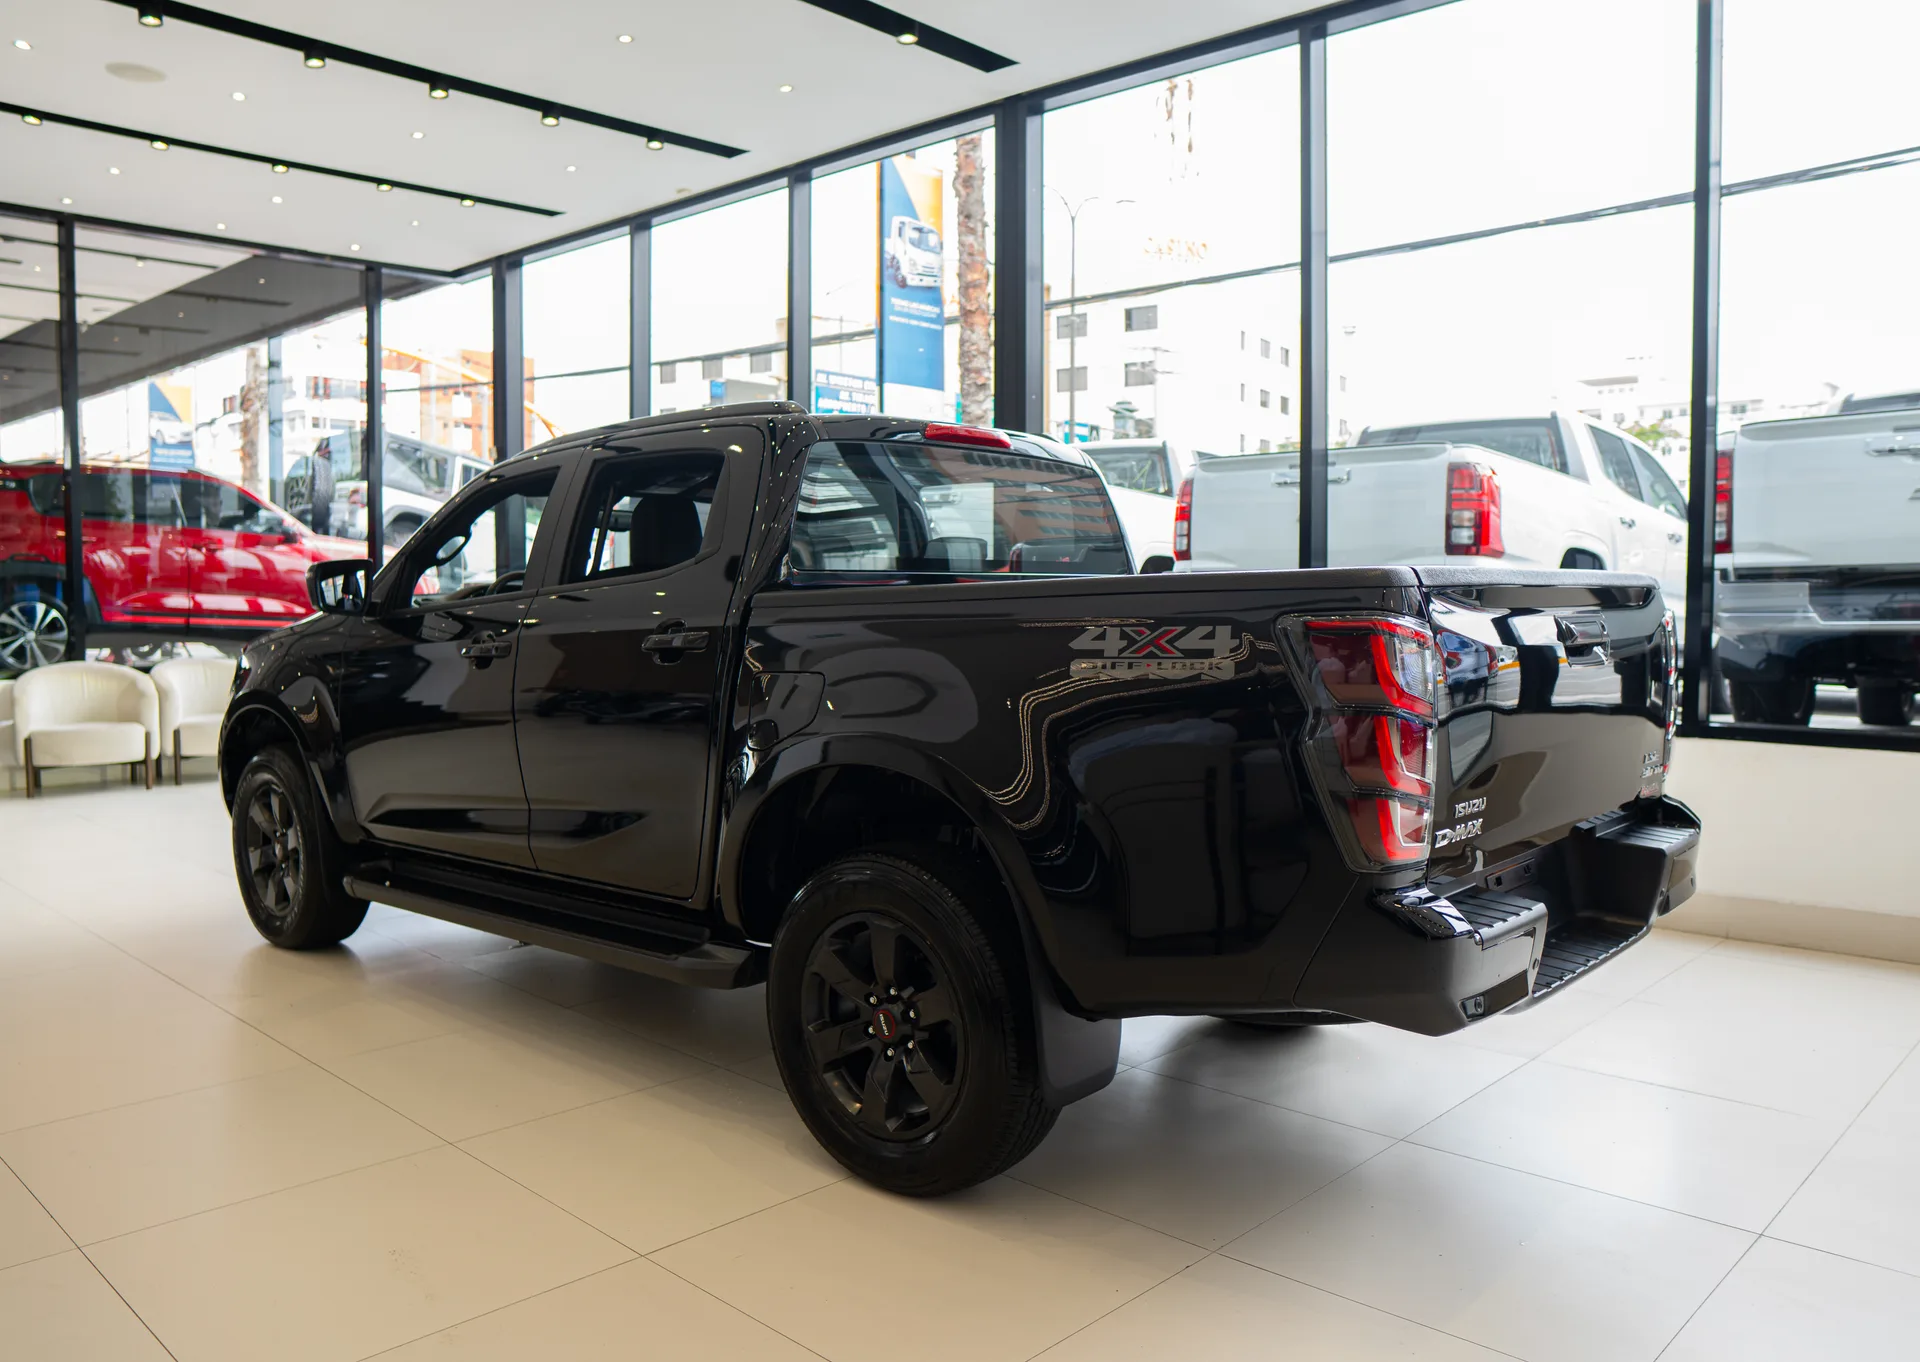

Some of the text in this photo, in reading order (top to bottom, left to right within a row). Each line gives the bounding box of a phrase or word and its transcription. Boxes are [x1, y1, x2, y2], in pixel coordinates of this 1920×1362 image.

[1156, 660, 1224, 671] LOCK
[1454, 797, 1486, 818] ISUZU
[879, 1013, 889, 1035] ISUZU
